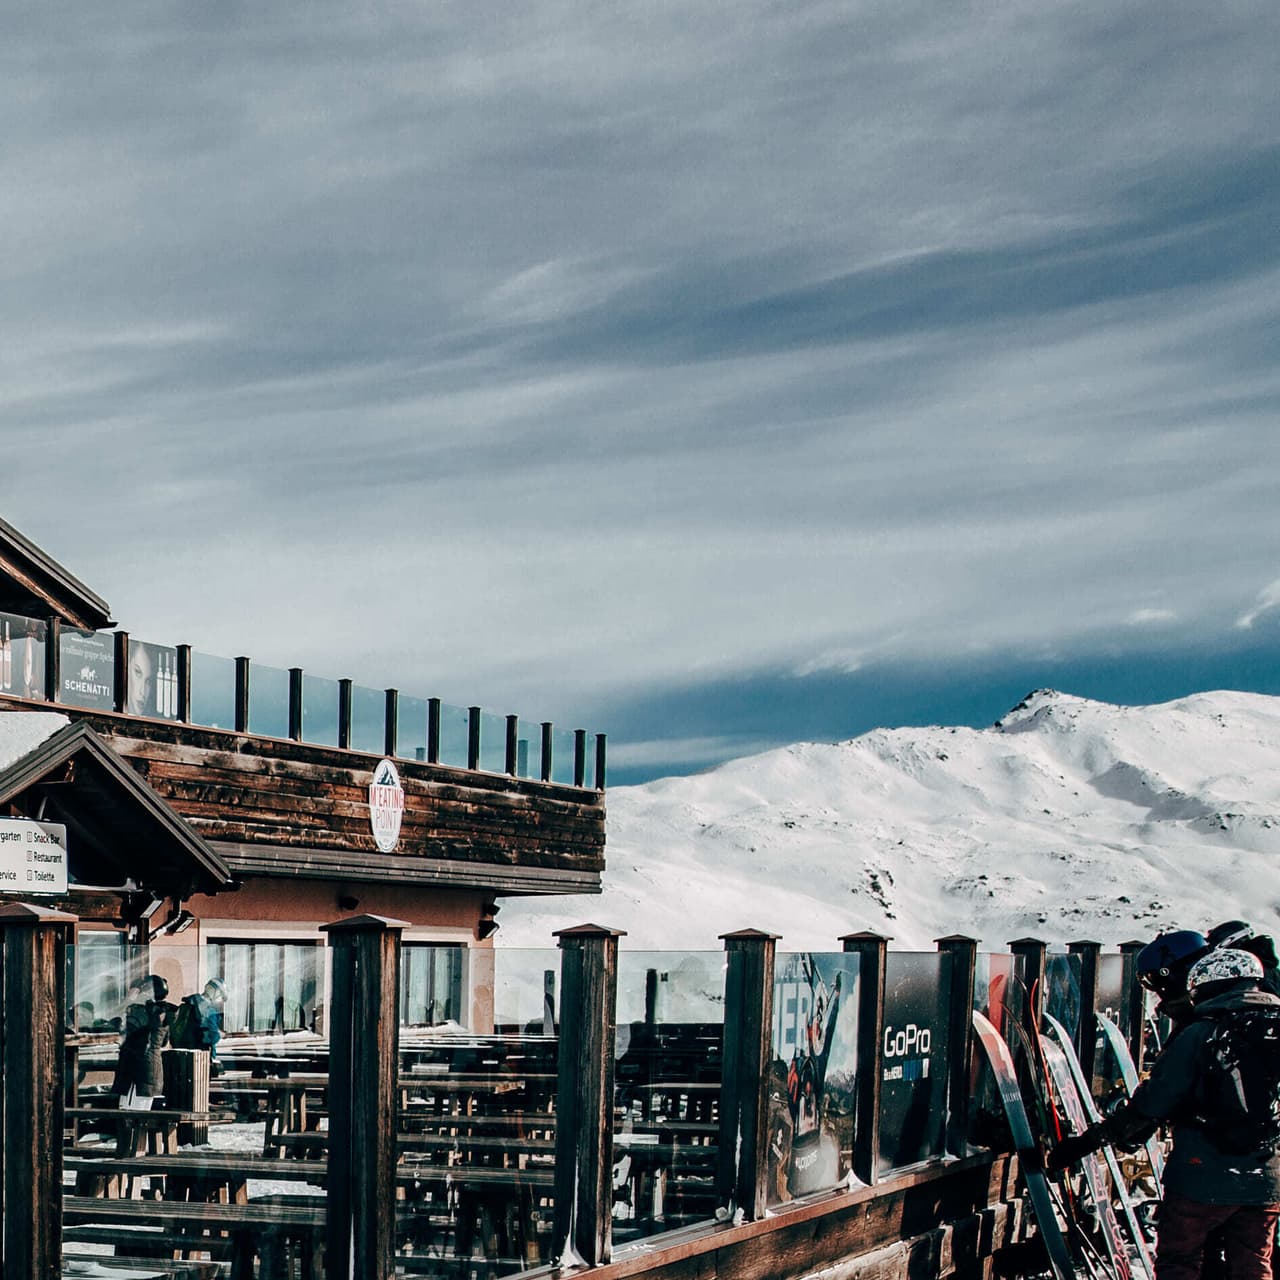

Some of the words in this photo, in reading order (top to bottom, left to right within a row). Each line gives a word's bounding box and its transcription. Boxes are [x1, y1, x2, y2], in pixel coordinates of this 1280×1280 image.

[65, 680, 110, 697] SCHENATTI
[375, 809, 399, 829] POINT
[33, 832, 49, 844] Snack
[50, 833, 60, 845] Bar
[33, 851, 62, 863] Restaurant
[34, 870, 55, 881] Toilette
[884, 1024, 930, 1057] GoPro
